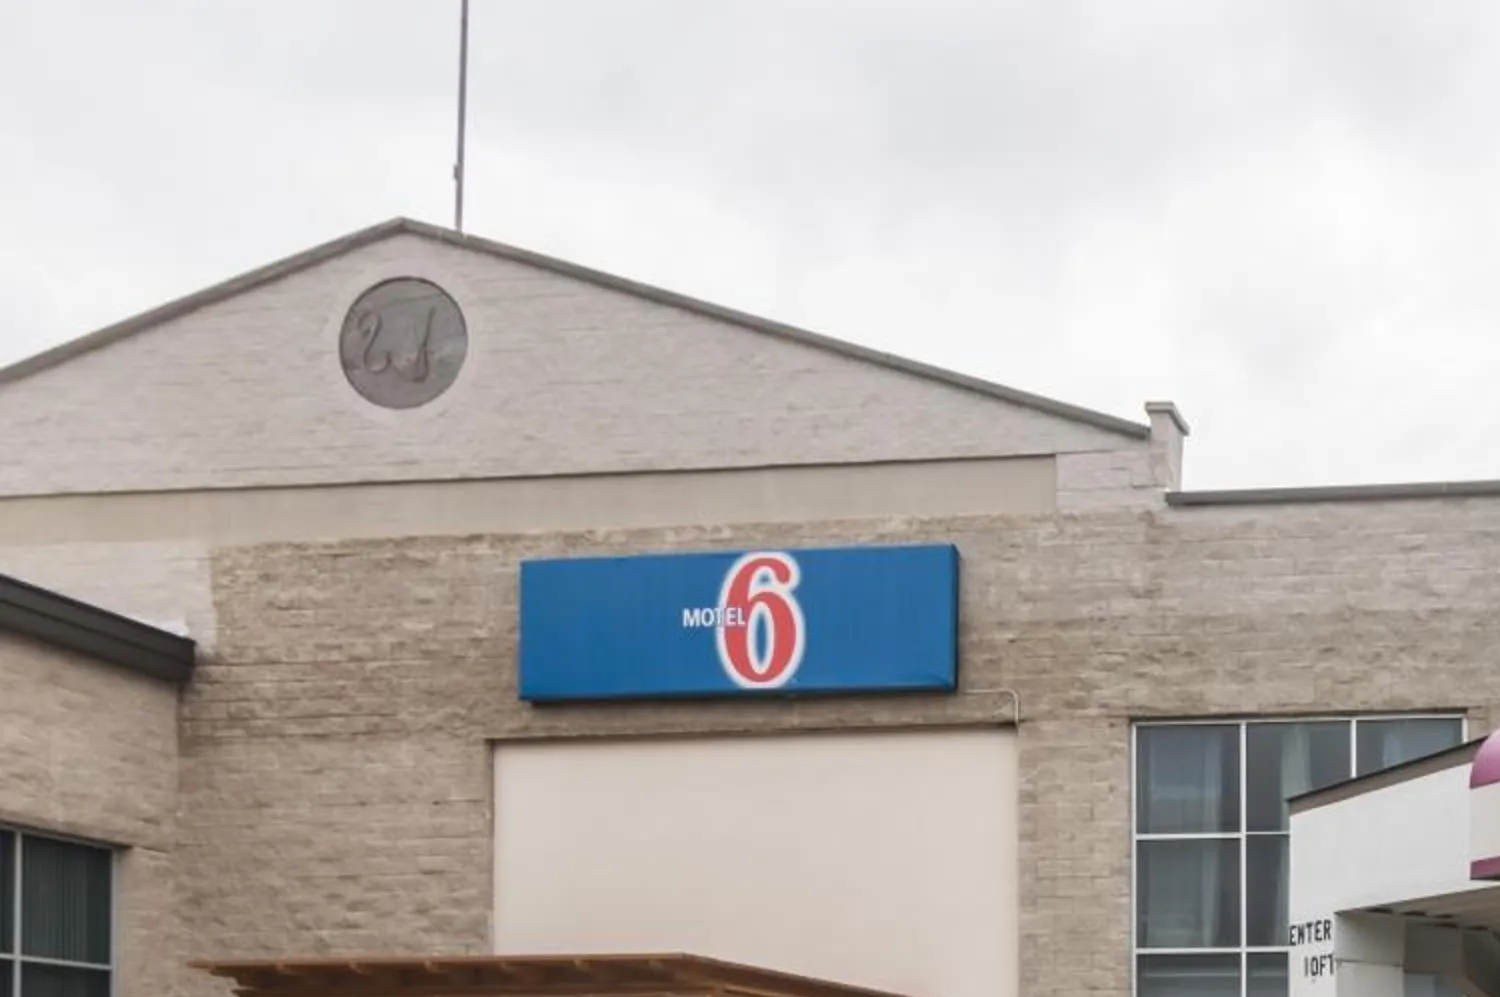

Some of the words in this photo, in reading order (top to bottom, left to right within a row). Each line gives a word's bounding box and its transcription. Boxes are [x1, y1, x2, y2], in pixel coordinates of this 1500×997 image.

[682, 608, 746, 628] MOTEL
[716, 551, 806, 688] 6
[1289, 919, 1332, 946] ENTER
